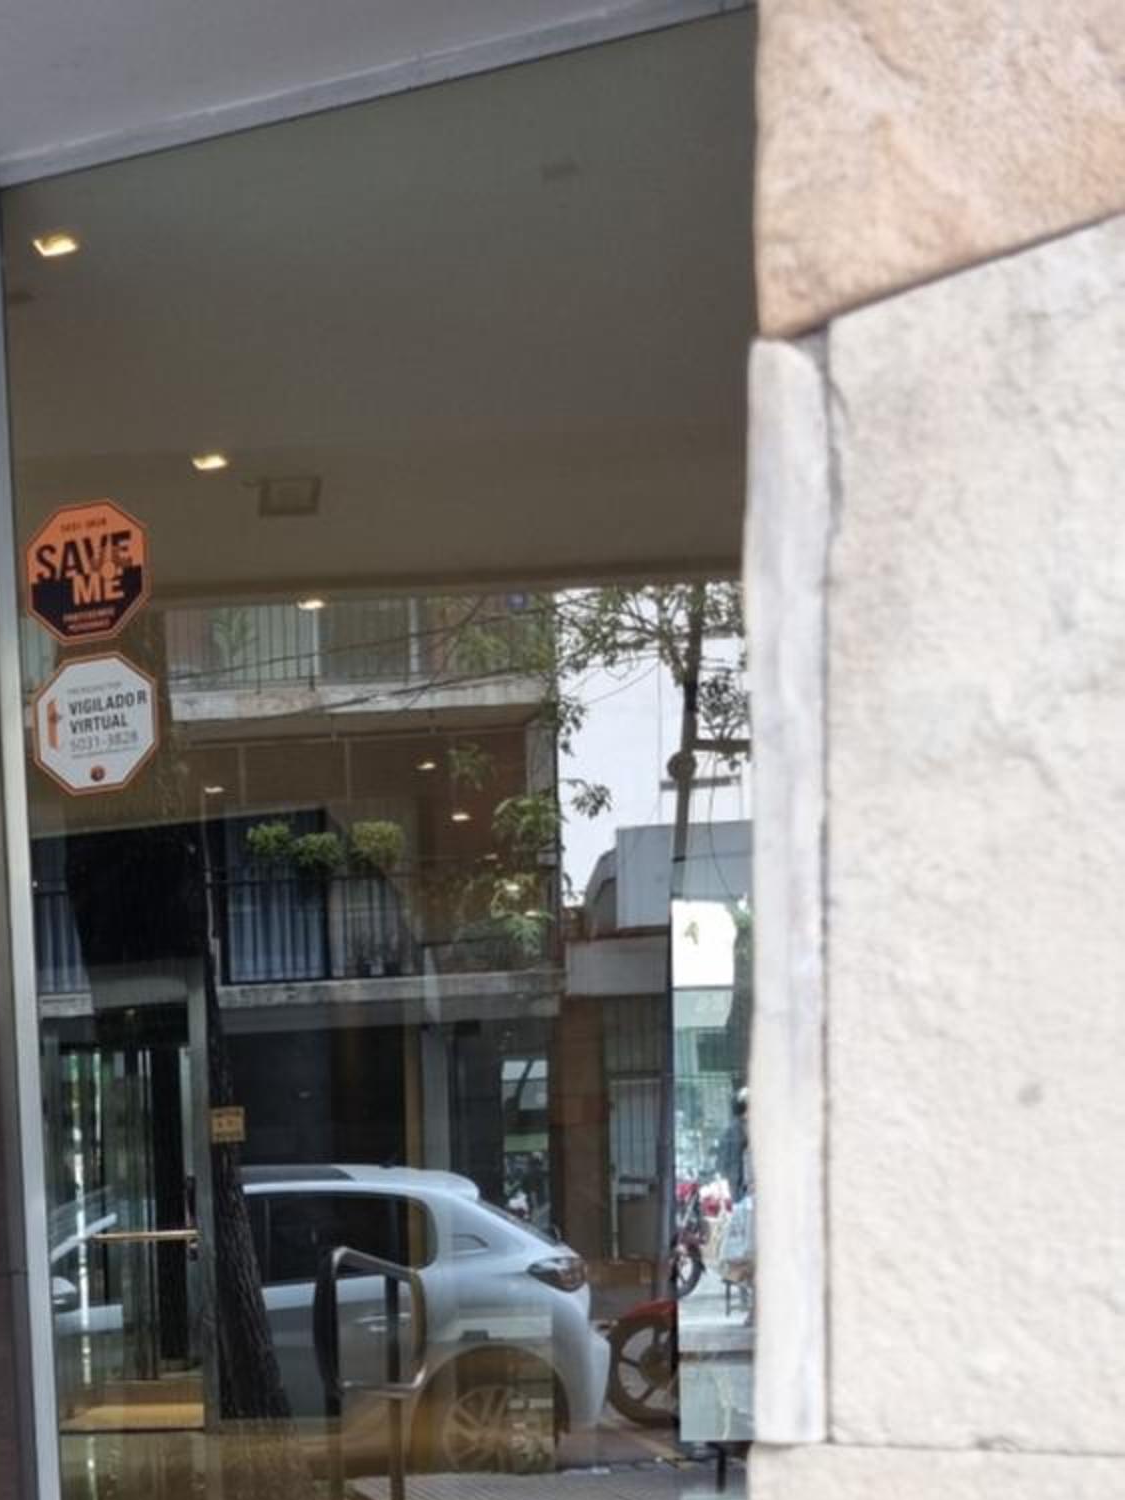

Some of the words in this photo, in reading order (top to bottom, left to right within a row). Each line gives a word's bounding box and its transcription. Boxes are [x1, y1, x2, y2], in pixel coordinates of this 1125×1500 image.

[35, 531, 132, 581] SAVE
[73, 574, 124, 605] ME
[69, 690, 147, 715] VIGILADOR
[69, 713, 127, 734] VIRTUAL
